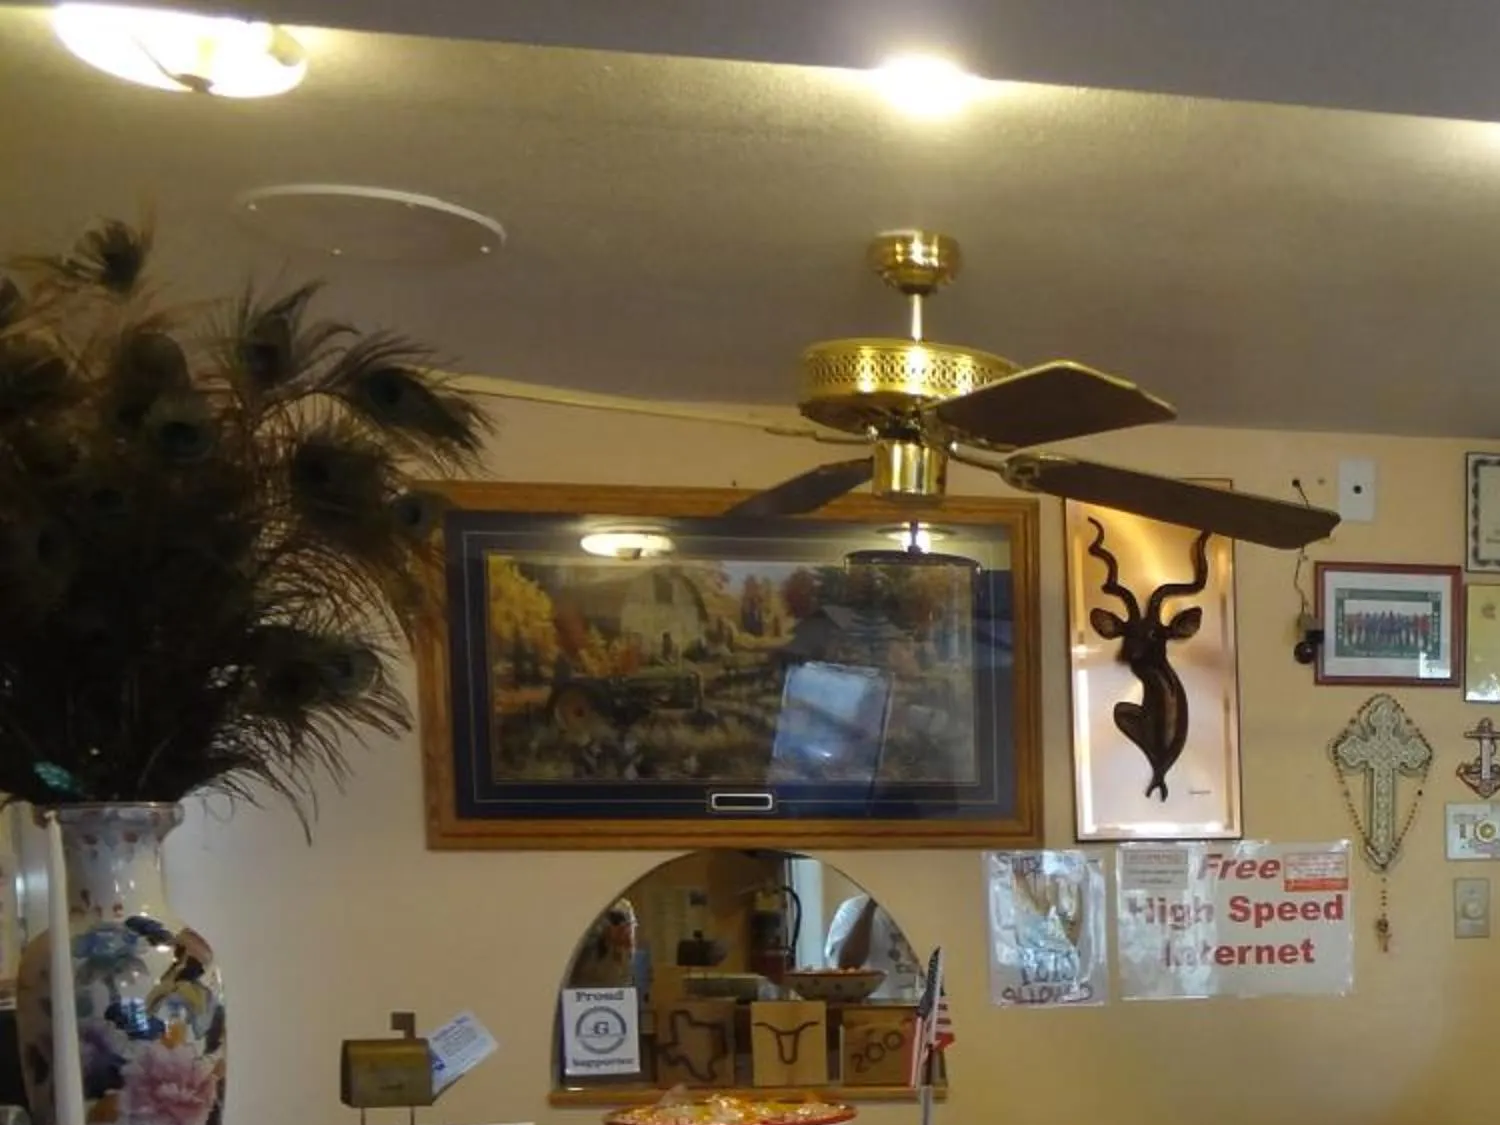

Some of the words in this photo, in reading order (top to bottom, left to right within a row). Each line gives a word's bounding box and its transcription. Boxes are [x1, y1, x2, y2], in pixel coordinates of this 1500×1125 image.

[1198, 853, 1281, 881] Free
[1228, 894, 1344, 928] Speed
[575, 988, 625, 1003] Proud
